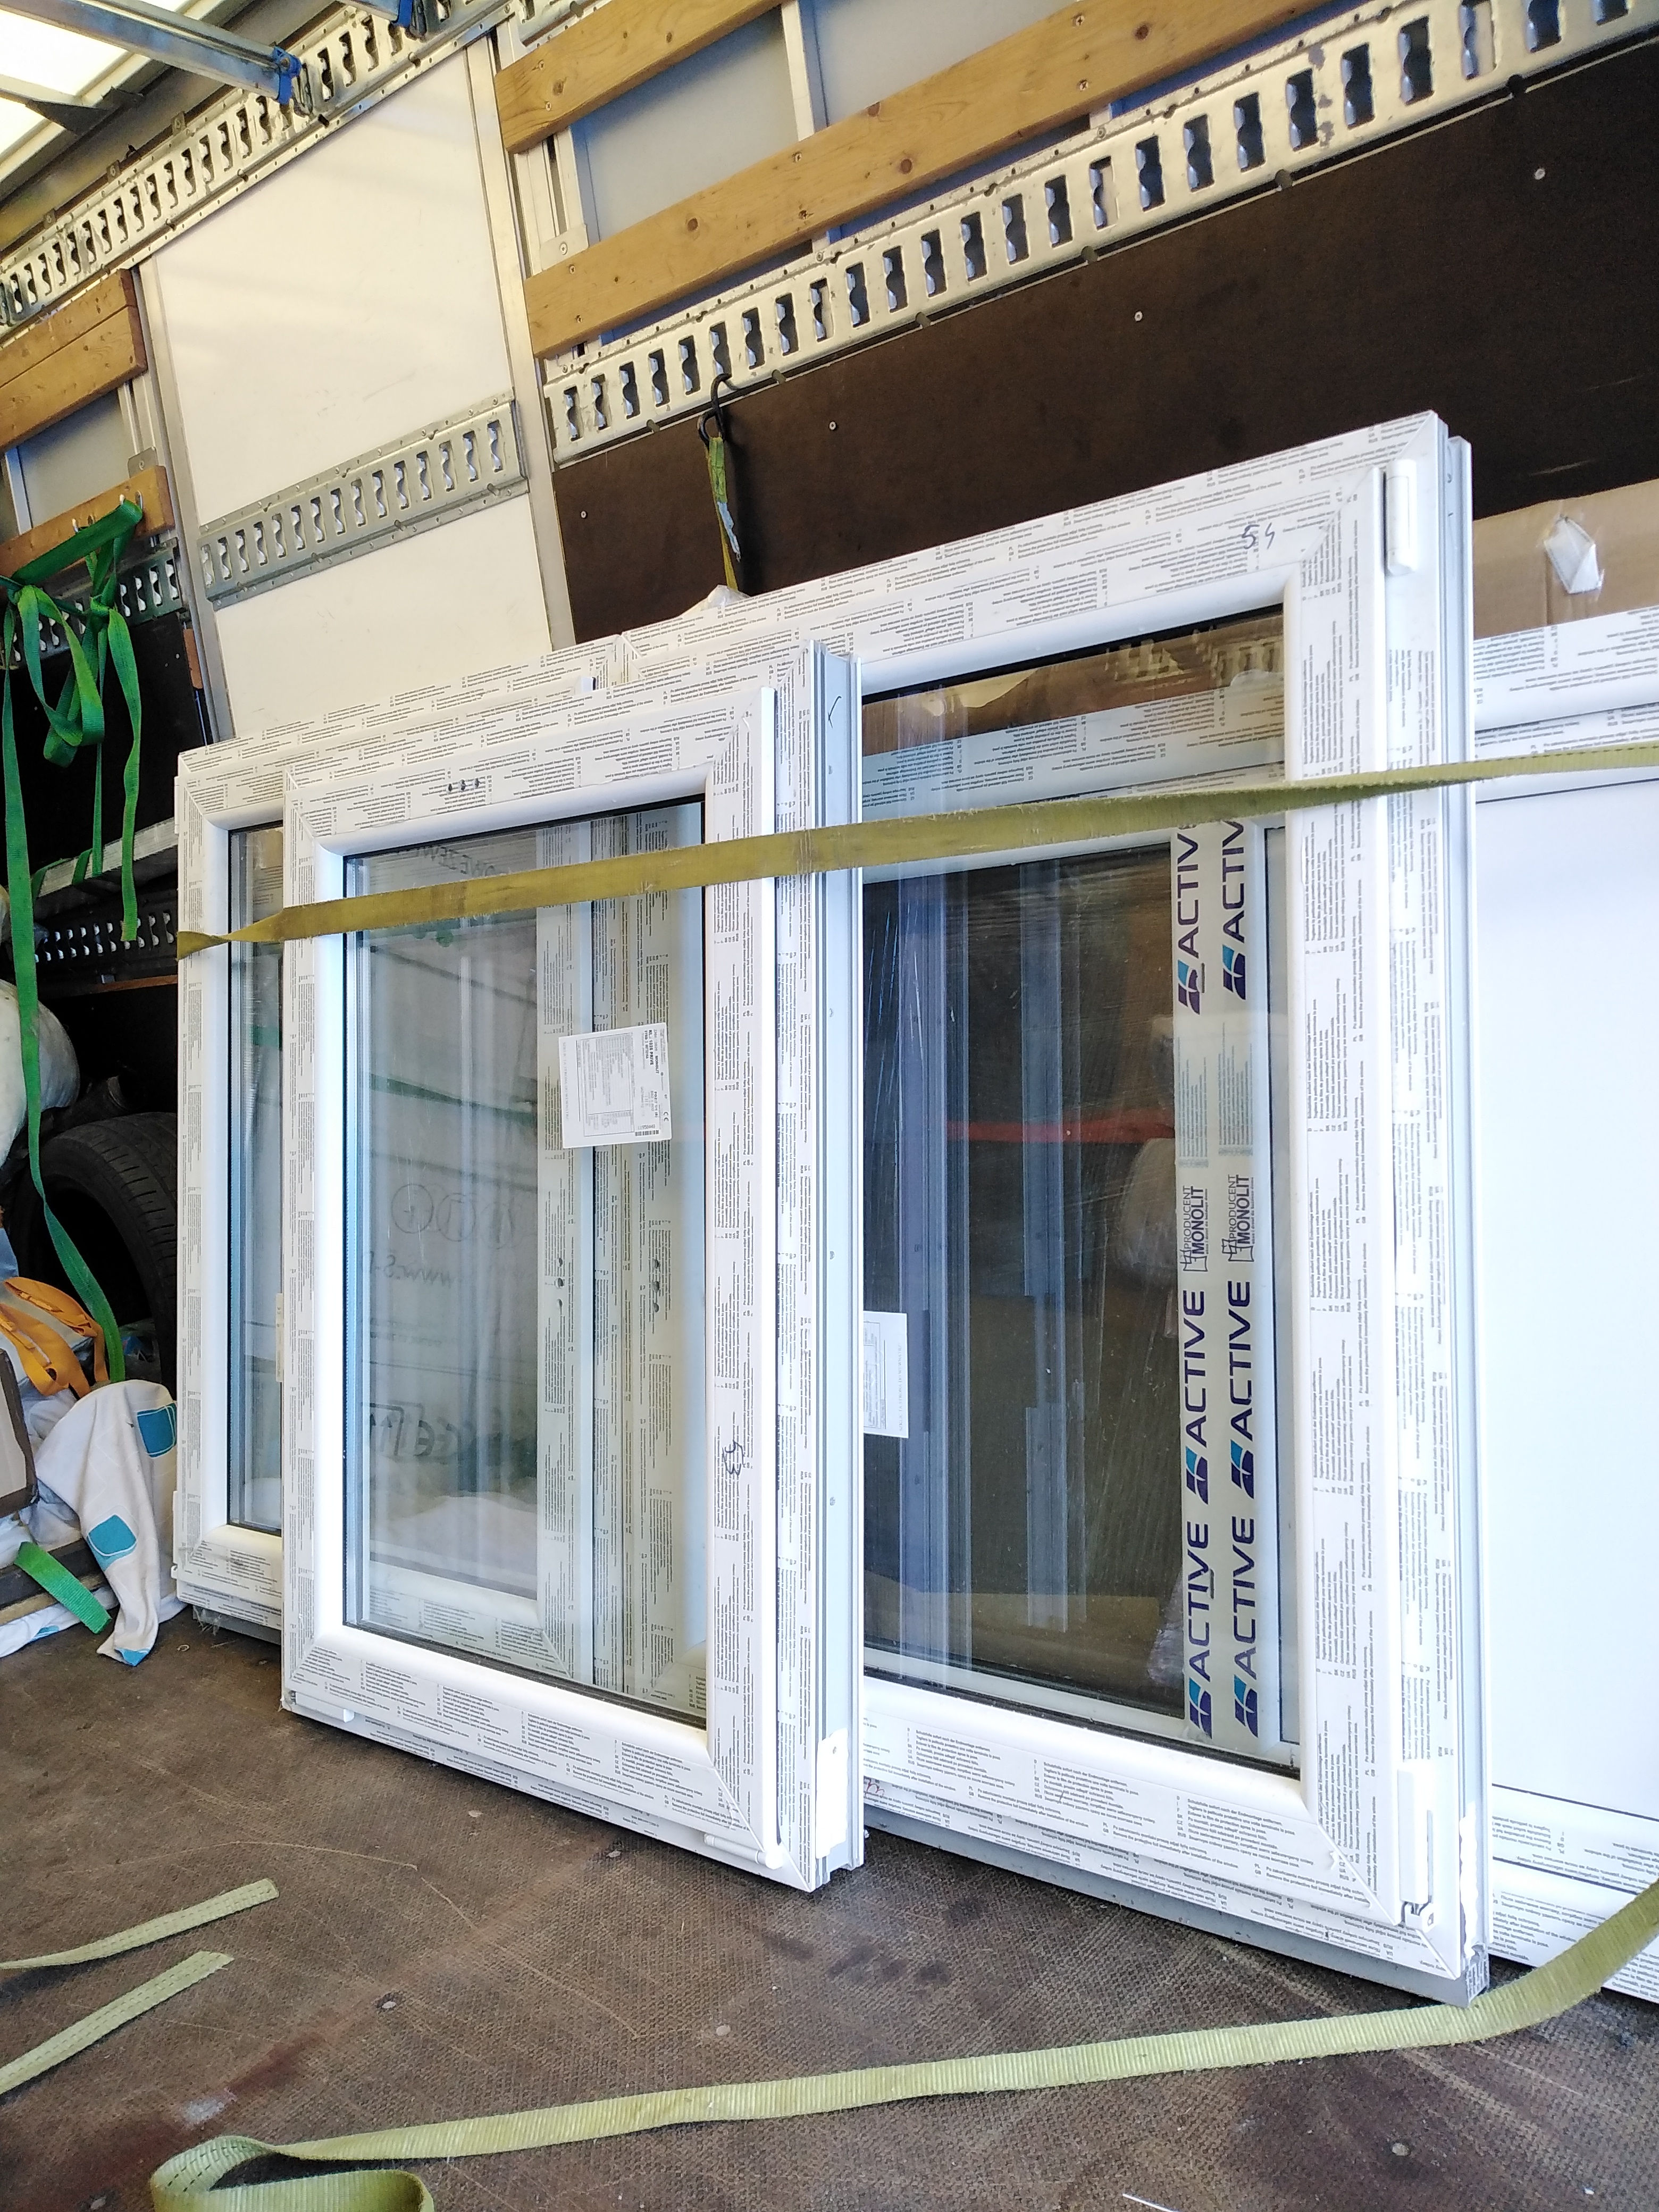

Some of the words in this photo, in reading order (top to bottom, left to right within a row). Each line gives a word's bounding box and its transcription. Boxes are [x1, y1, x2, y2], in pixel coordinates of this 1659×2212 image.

[1177, 824, 1199, 959] ACTIV
[1222, 820, 1245, 944] ACTIV
[1183, 1185, 1191, 1249] PRODUCENT
[1191, 1186, 1205, 1255] MONOLIT
[1228, 1174, 1237, 1239] PRODUCENT
[1236, 1174, 1250, 1245] MONOLIT
[1183, 1290, 1207, 1448] ACTIVE
[1227, 1280, 1253, 1442] ACTIVE
[1187, 1521, 1210, 1682] ACTIVE
[1232, 1516, 1257, 1680] ACTIVE
